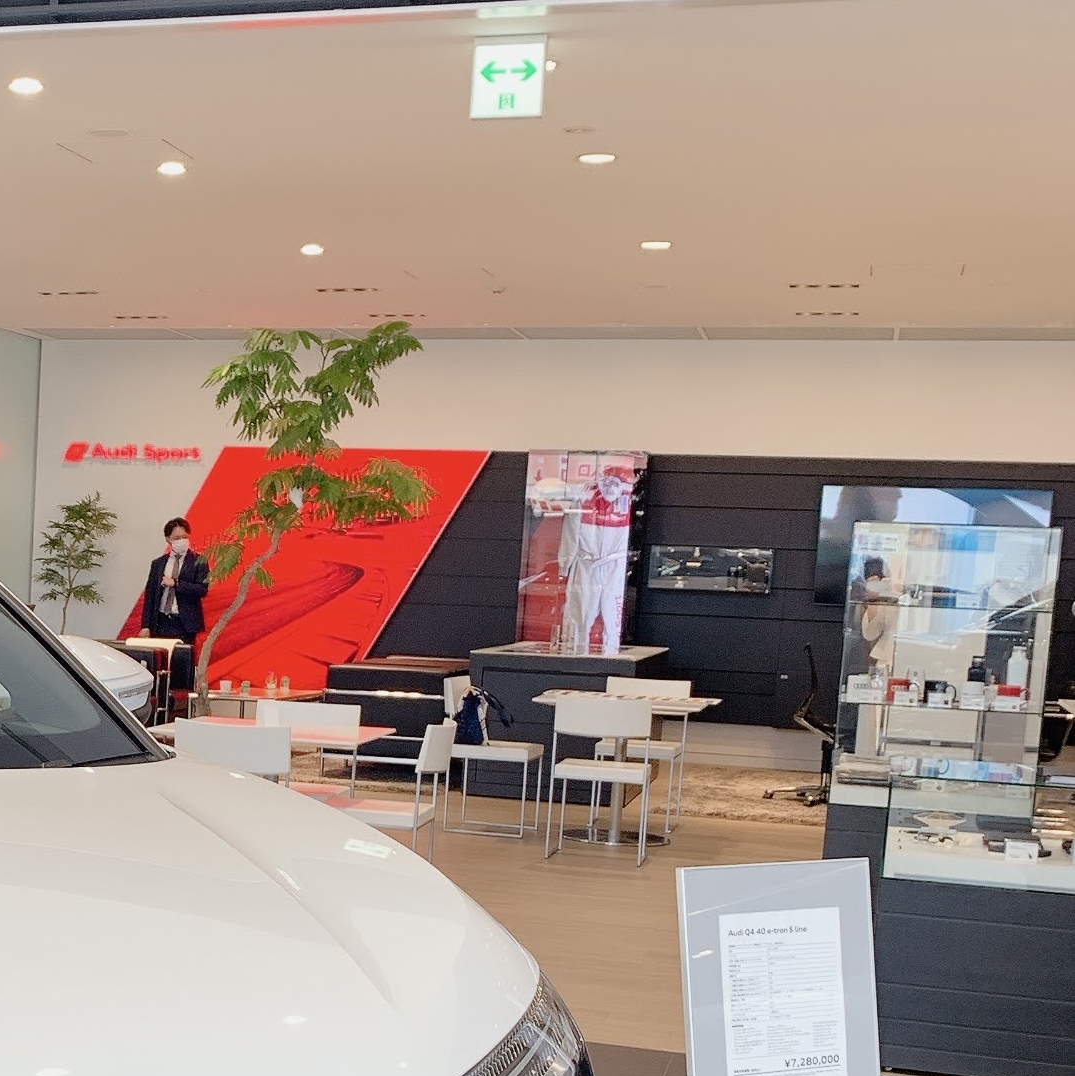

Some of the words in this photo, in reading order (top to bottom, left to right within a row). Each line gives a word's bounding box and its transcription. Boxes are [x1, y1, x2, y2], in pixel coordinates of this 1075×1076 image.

[91, 442, 137, 459] Audi
[143, 443, 201, 463] Sport
[744, 928, 755, 936] Q4
[756, 927, 766, 935] 40
[767, 926, 788, 934] e-tron
[789, 925, 794, 933] S
[794, 925, 807, 933] line
[784, 1054, 840, 1068] ¥7,280,000
